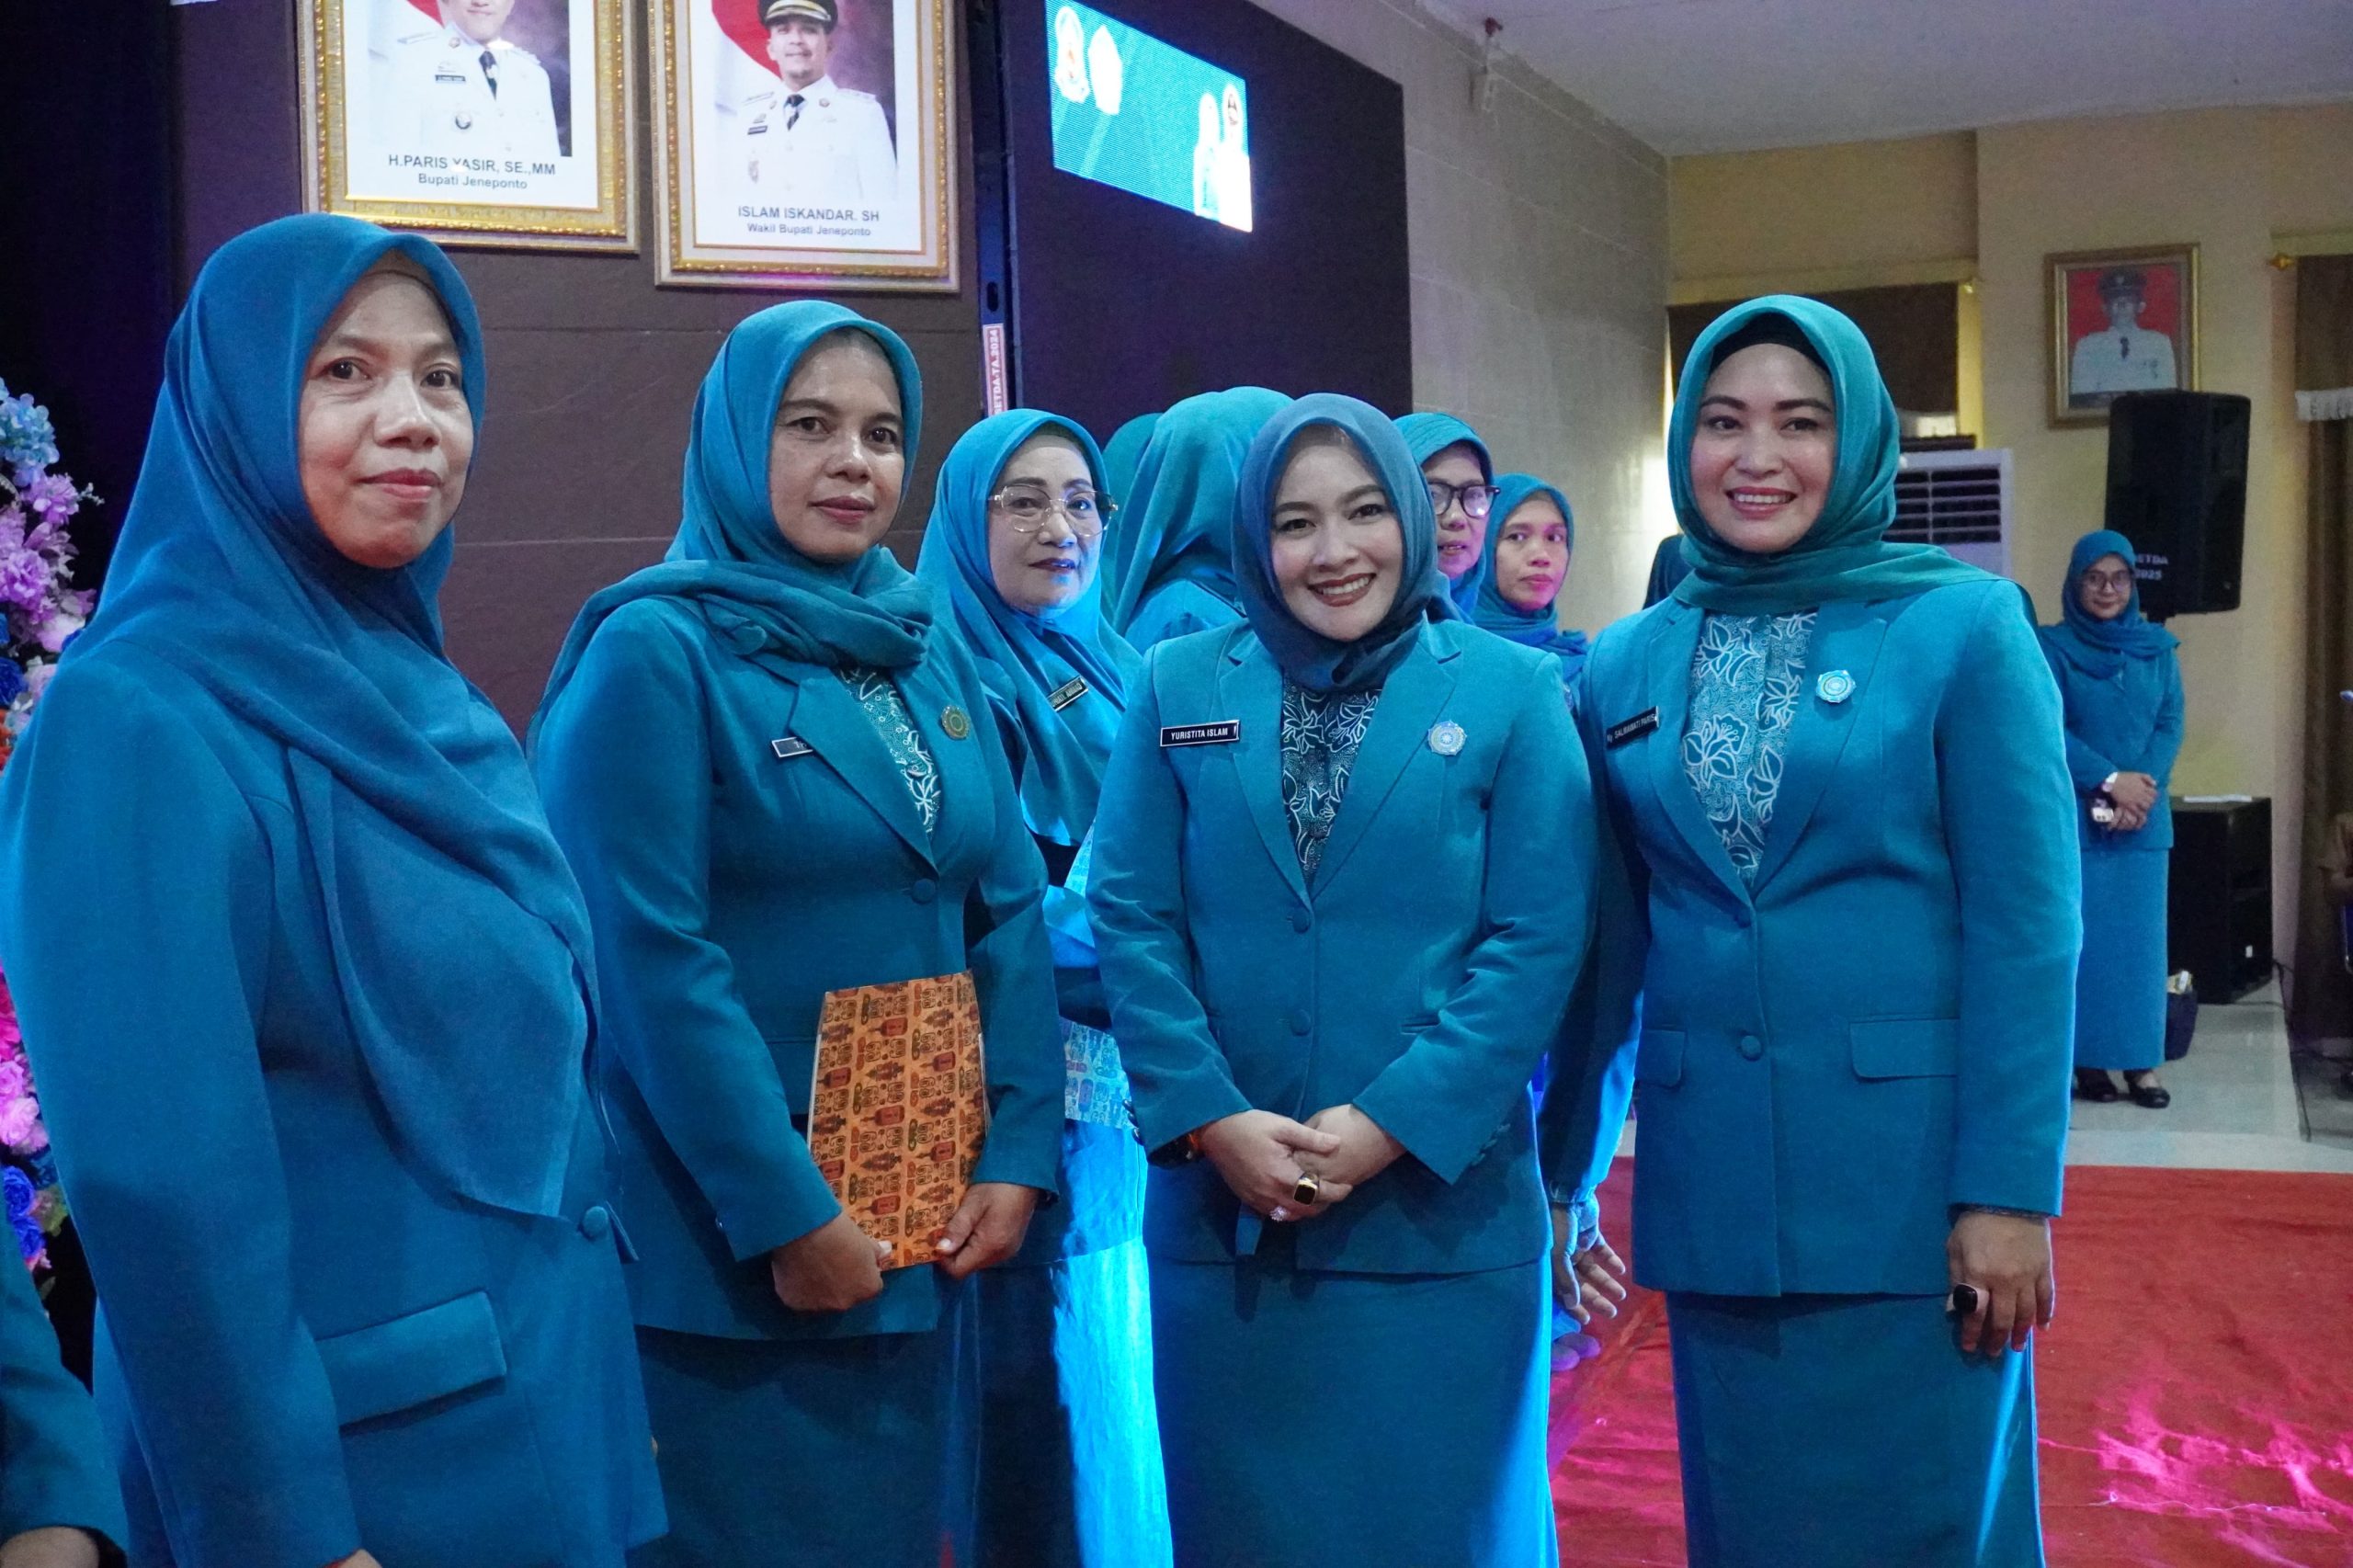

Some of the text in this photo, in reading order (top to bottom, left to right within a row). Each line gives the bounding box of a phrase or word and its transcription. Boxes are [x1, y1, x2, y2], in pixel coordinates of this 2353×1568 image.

[389, 154, 449, 169] H.PARIS
[418, 173, 528, 190] Bupati Jeneponto
[738, 206, 780, 219] ISLAM
[861, 210, 880, 222] SH
[747, 222, 871, 237] Wakil Bupati Jeneponto
[1171, 727, 1228, 741] YURISTITA ISLAM
